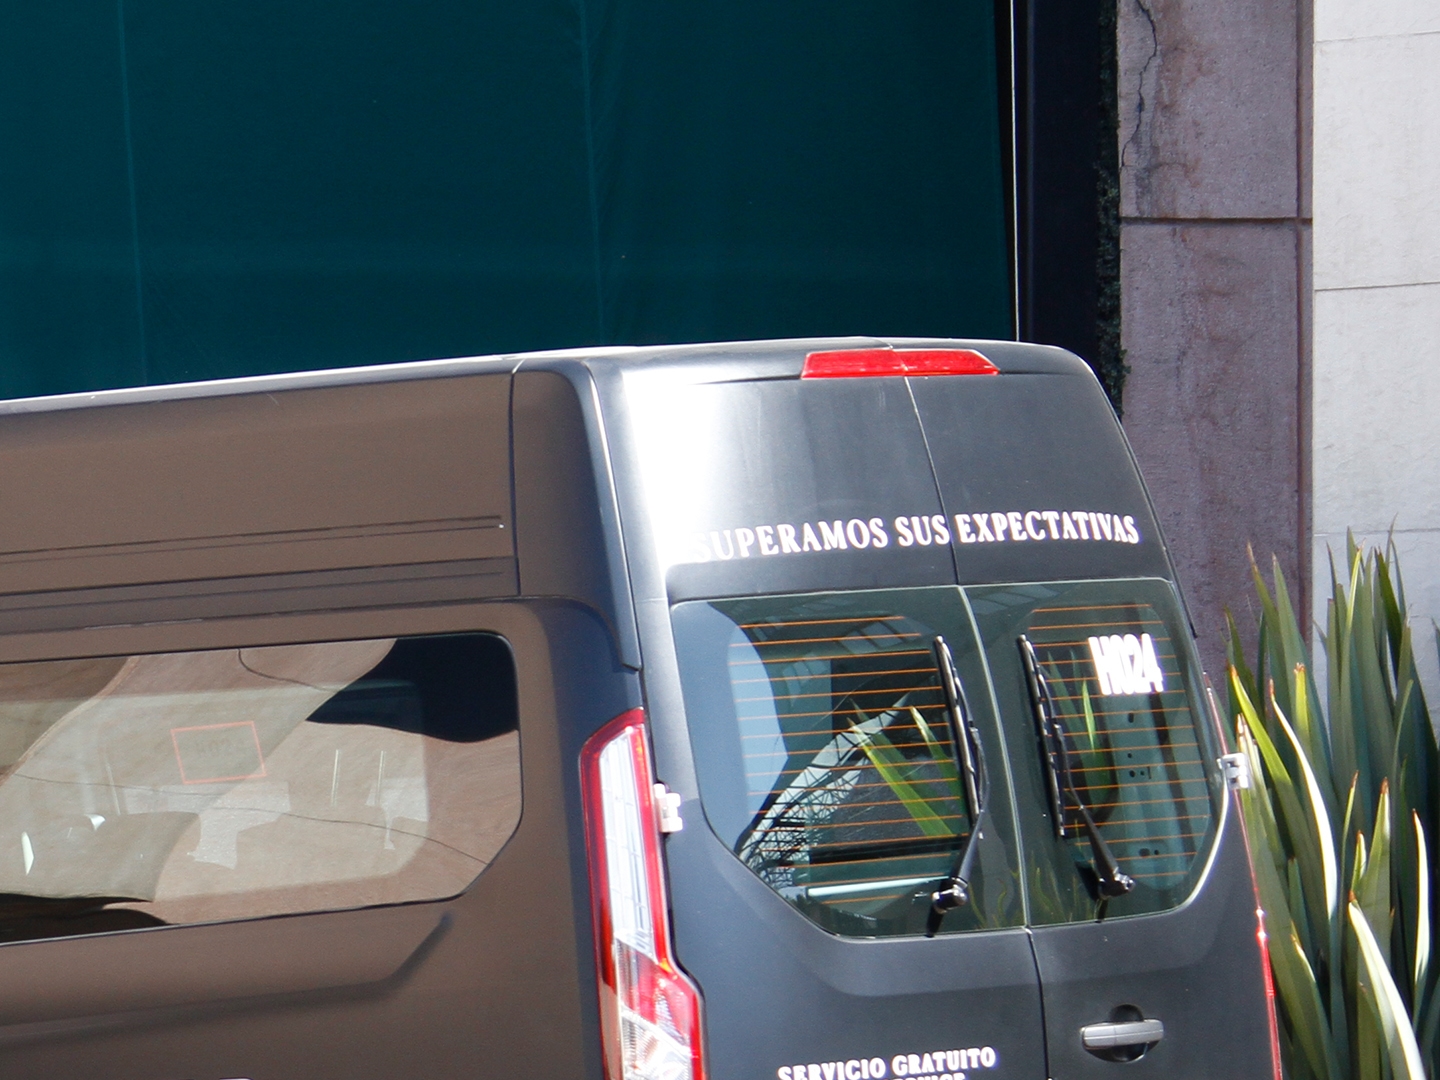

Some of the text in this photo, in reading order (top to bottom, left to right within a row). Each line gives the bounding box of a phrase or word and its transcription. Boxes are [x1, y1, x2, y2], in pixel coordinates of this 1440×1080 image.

[690, 510, 1141, 563] SUPERAMOS SUS EXPECTATIVAS
[891, 1046, 997, 1075] GRATUITO
